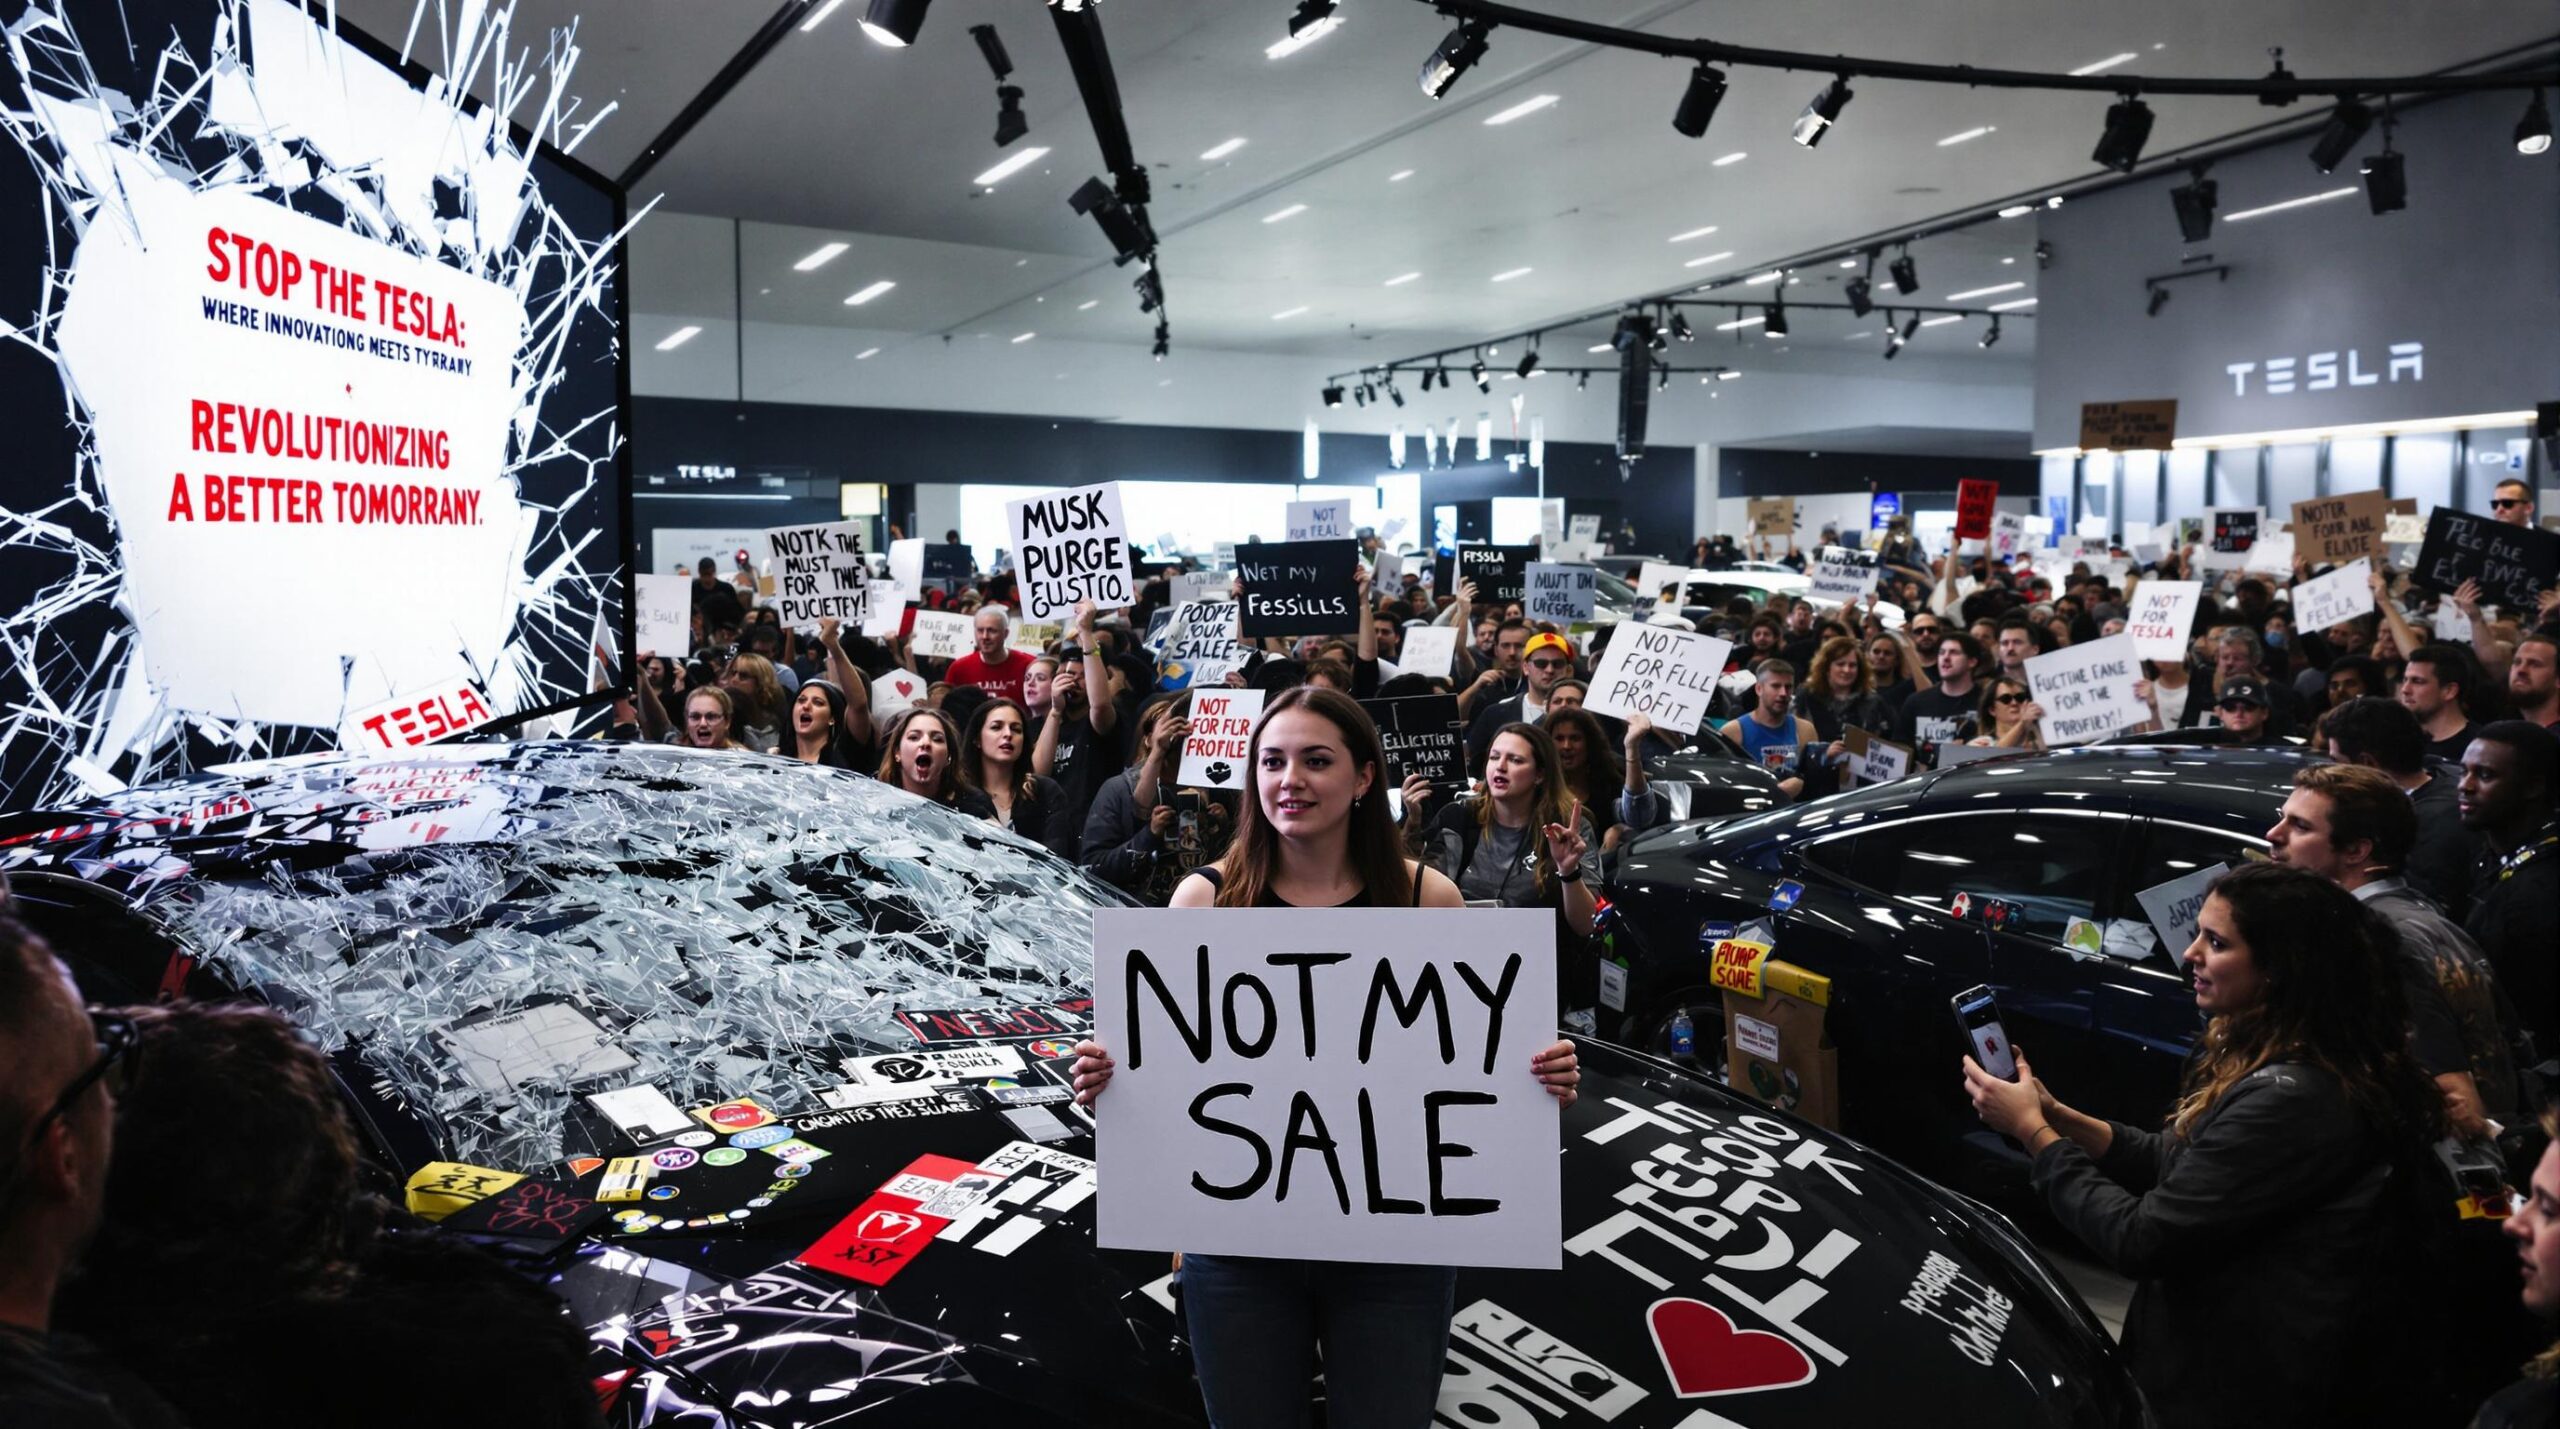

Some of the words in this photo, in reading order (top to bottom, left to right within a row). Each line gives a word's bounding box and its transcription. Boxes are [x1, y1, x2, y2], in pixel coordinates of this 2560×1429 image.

[207, 227, 302, 300] STOP
[310, 259, 367, 332] THE
[375, 279, 467, 349] TESLA:
[202, 295, 259, 330] WHERE
[265, 311, 365, 352] INNOVATIONG
[369, 336, 411, 363] MEETS
[2226, 342, 2424, 396] TESLA
[192, 399, 450, 470] REVOLUTIONIZING
[168, 473, 194, 522] A
[204, 474, 323, 523] BETTER
[333, 481, 483, 525] TOMORRANY.
[1023, 490, 1110, 540] MUSK
[1313, 507, 1336, 521] NOT
[785, 555, 830, 575] MUST
[1023, 537, 1123, 583] PURGE
[784, 574, 820, 597] FOR
[2147, 594, 2183, 609] NOT
[2131, 625, 2174, 639] TESLA
[2141, 610, 2168, 623] FOR
[1620, 652, 1665, 680] FOR
[362, 688, 490, 749] TESLA
[1197, 698, 1230, 716] NOT
[2054, 691, 2085, 712] FOR
[1191, 717, 1219, 736] FOR
[1126, 945, 1353, 1071] NOT
[1357, 952, 1523, 1075] MY
[1188, 1082, 1501, 1217] SALE
